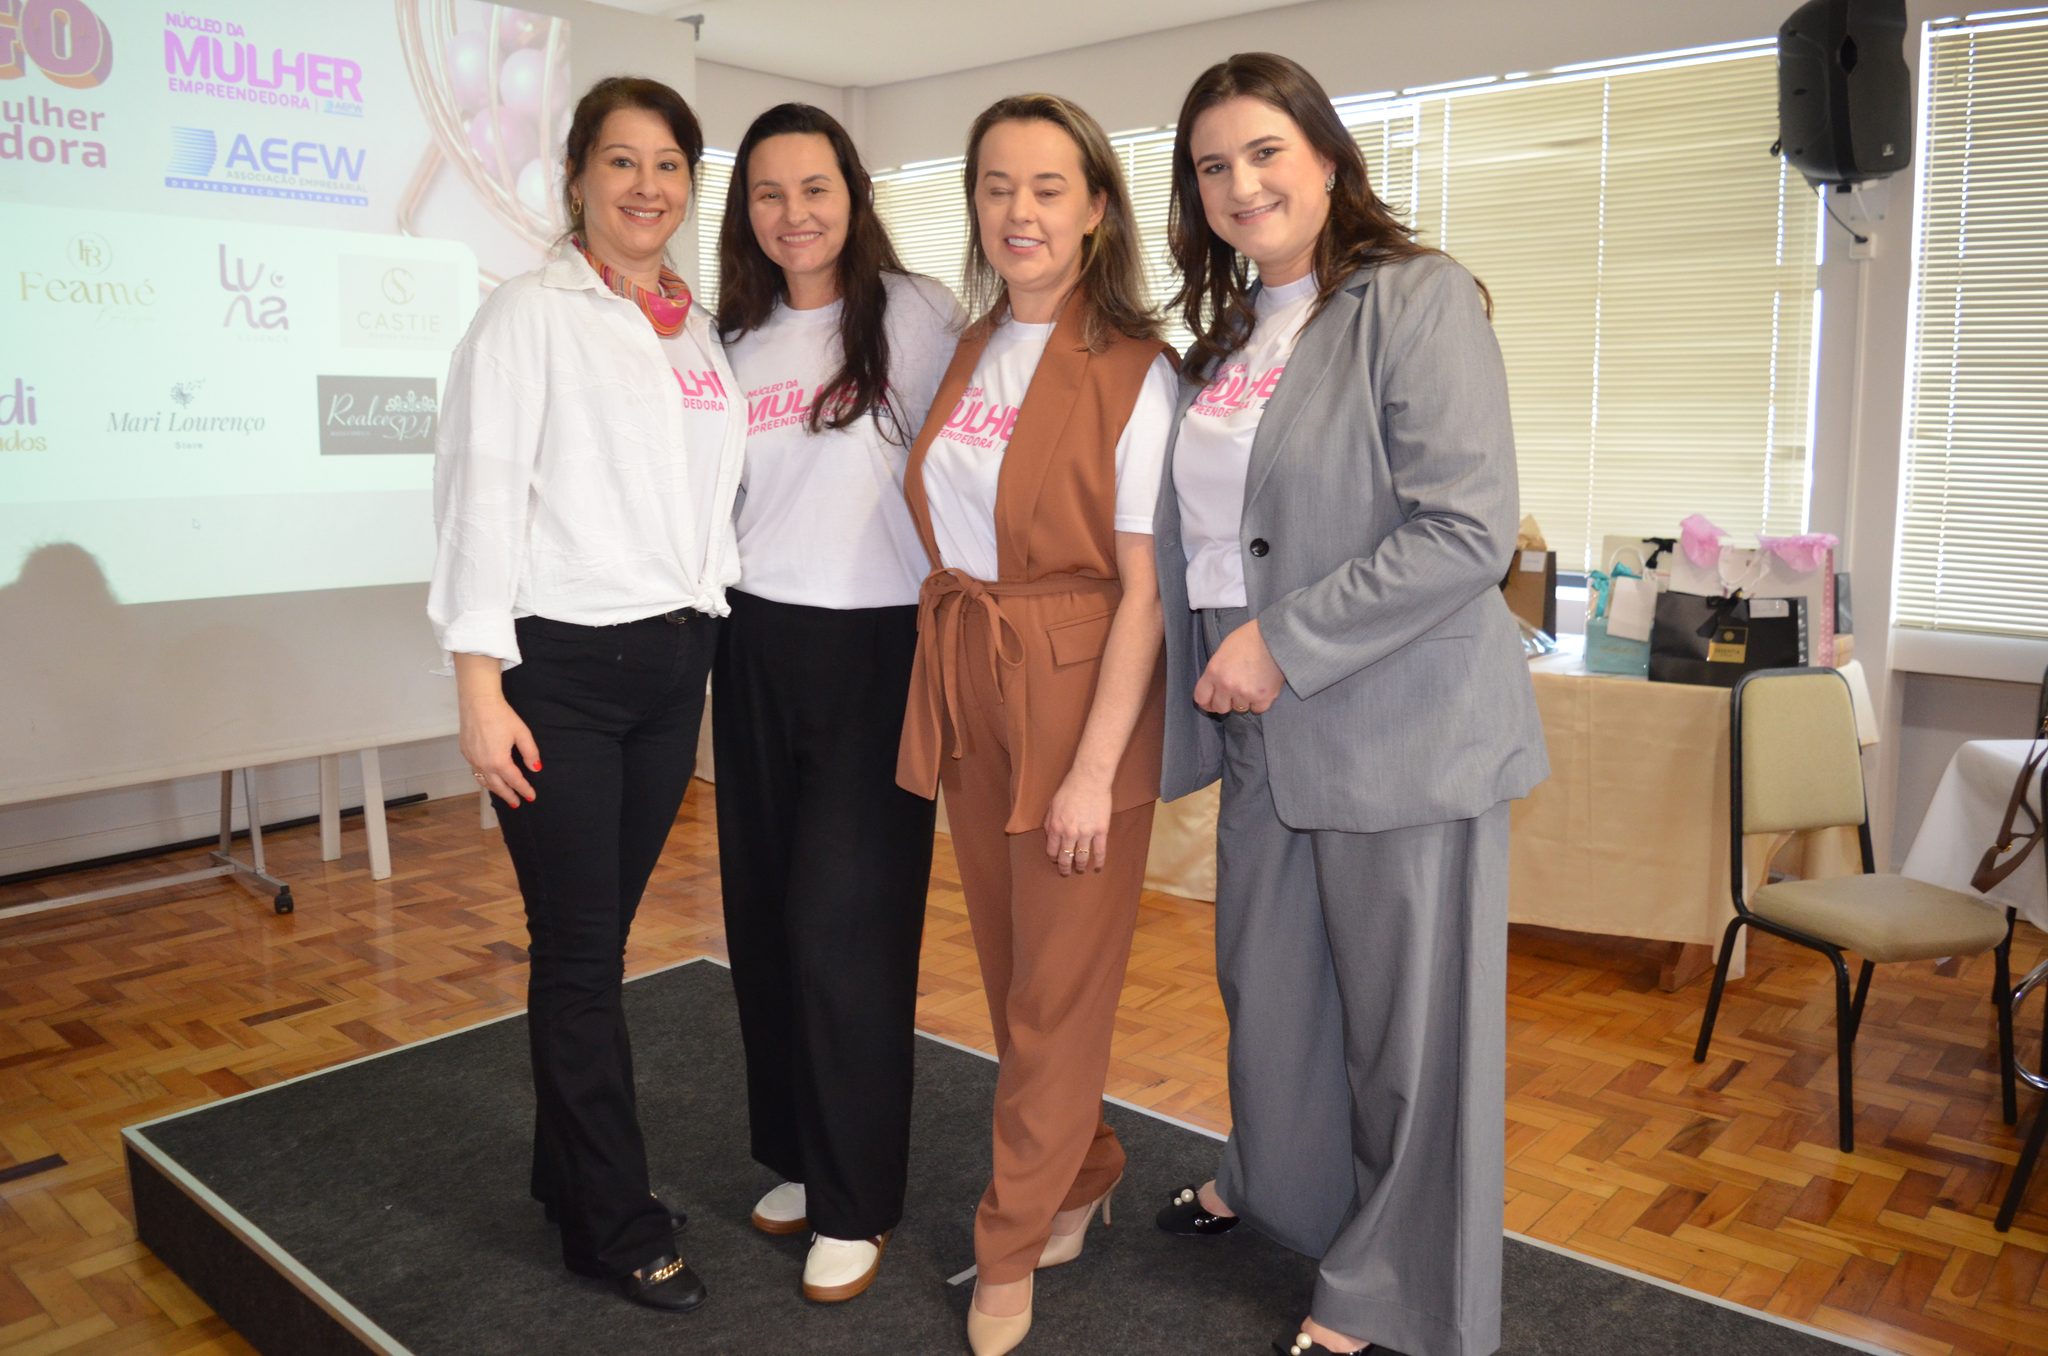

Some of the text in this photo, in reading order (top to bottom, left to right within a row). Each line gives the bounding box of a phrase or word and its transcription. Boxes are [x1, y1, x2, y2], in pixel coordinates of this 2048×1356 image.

[165, 11, 245, 37] NÚCLEO DA
[164, 29, 363, 103] MULHER
[168, 77, 310, 110] EMPREENDEDORA
[225, 133, 366, 182] AEFW
[226, 170, 296, 185] ASSOCIAÇÃO
[18, 271, 156, 306] Feamé
[357, 311, 440, 333] CASTIE
[786, 379, 798, 390] DA
[106, 411, 265, 437] Mari Lourenço
[327, 393, 390, 426] Realce
